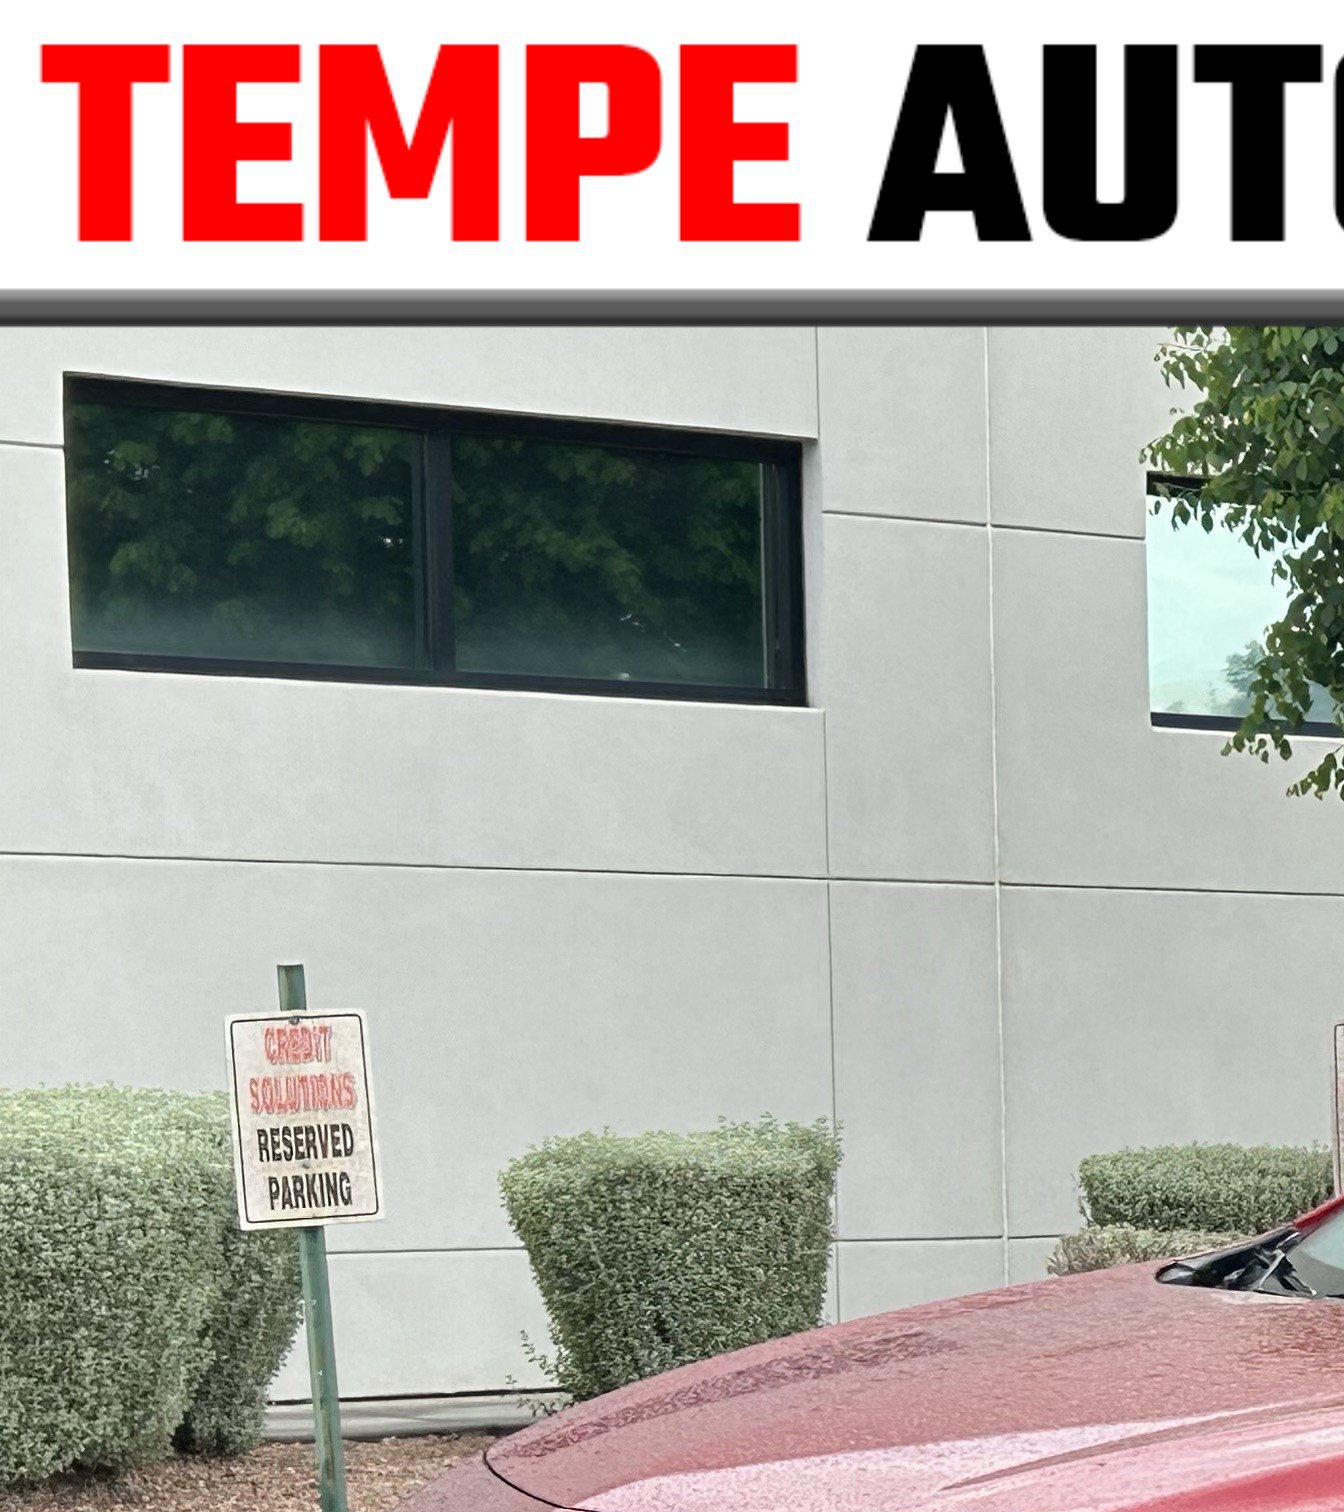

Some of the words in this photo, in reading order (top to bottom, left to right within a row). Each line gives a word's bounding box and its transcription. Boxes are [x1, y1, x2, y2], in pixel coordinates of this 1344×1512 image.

[262, 1025, 332, 1065] CREDIT
[249, 1072, 358, 1114] SOLUTIONS
[257, 1123, 354, 1162] RESERVED
[268, 1171, 353, 1210] PARKING
